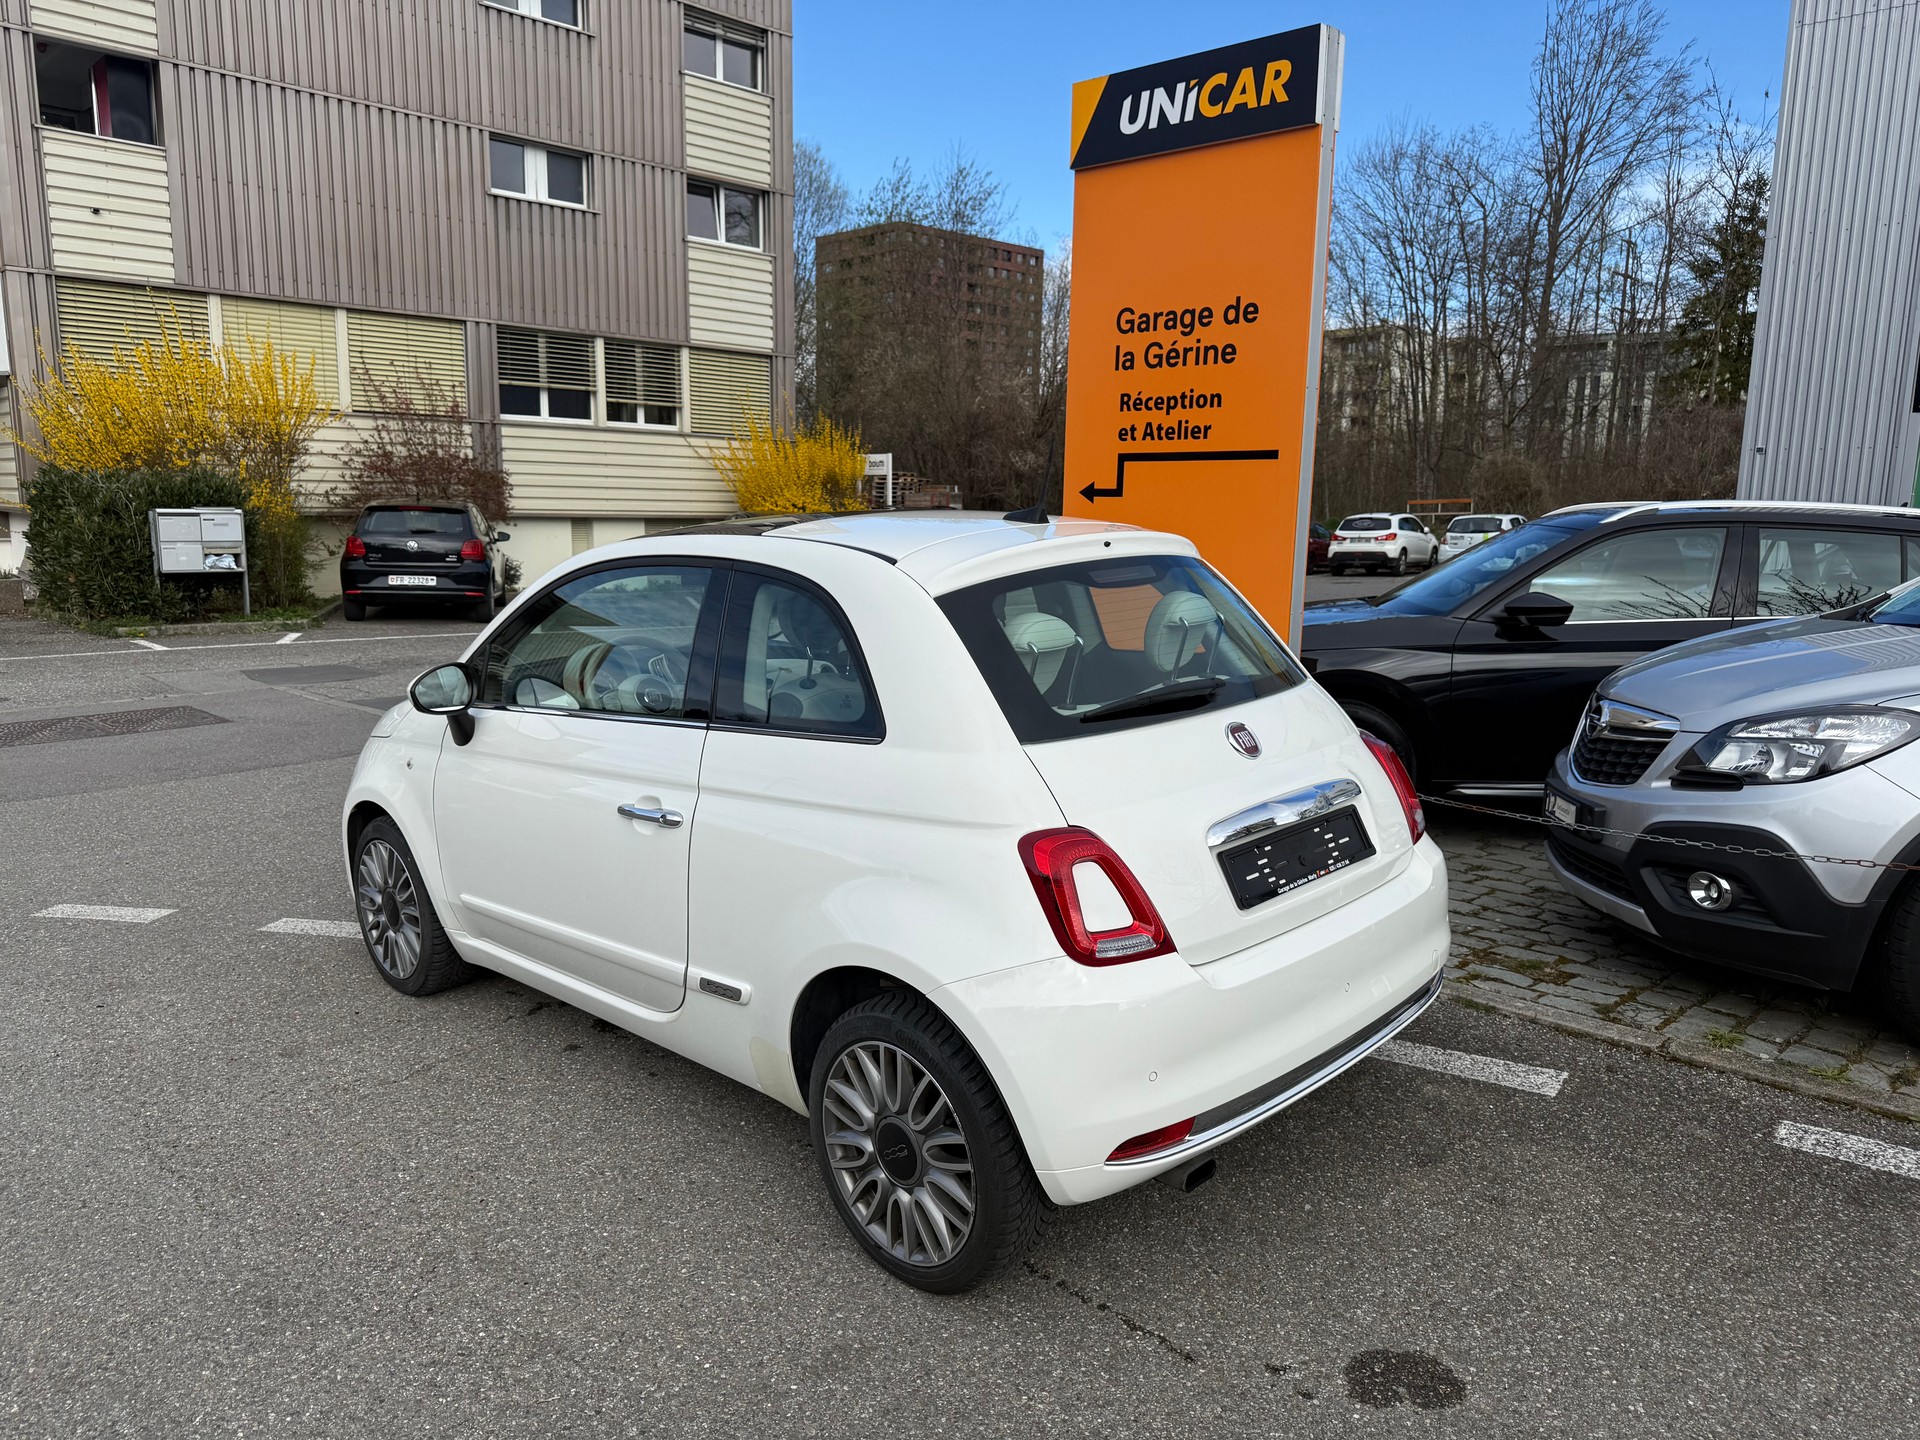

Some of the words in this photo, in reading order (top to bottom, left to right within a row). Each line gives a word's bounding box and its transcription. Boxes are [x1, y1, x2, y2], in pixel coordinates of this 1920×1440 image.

[1116, 305, 1214, 337] Garage
[1223, 295, 1259, 326] de
[1114, 345, 1135, 371] la
[1144, 338, 1237, 369] Gérine
[1119, 388, 1222, 415] Réception
[1118, 423, 1137, 441] et
[1142, 419, 1212, 441] Atelier
[1234, 730, 1256, 749] FIAT
